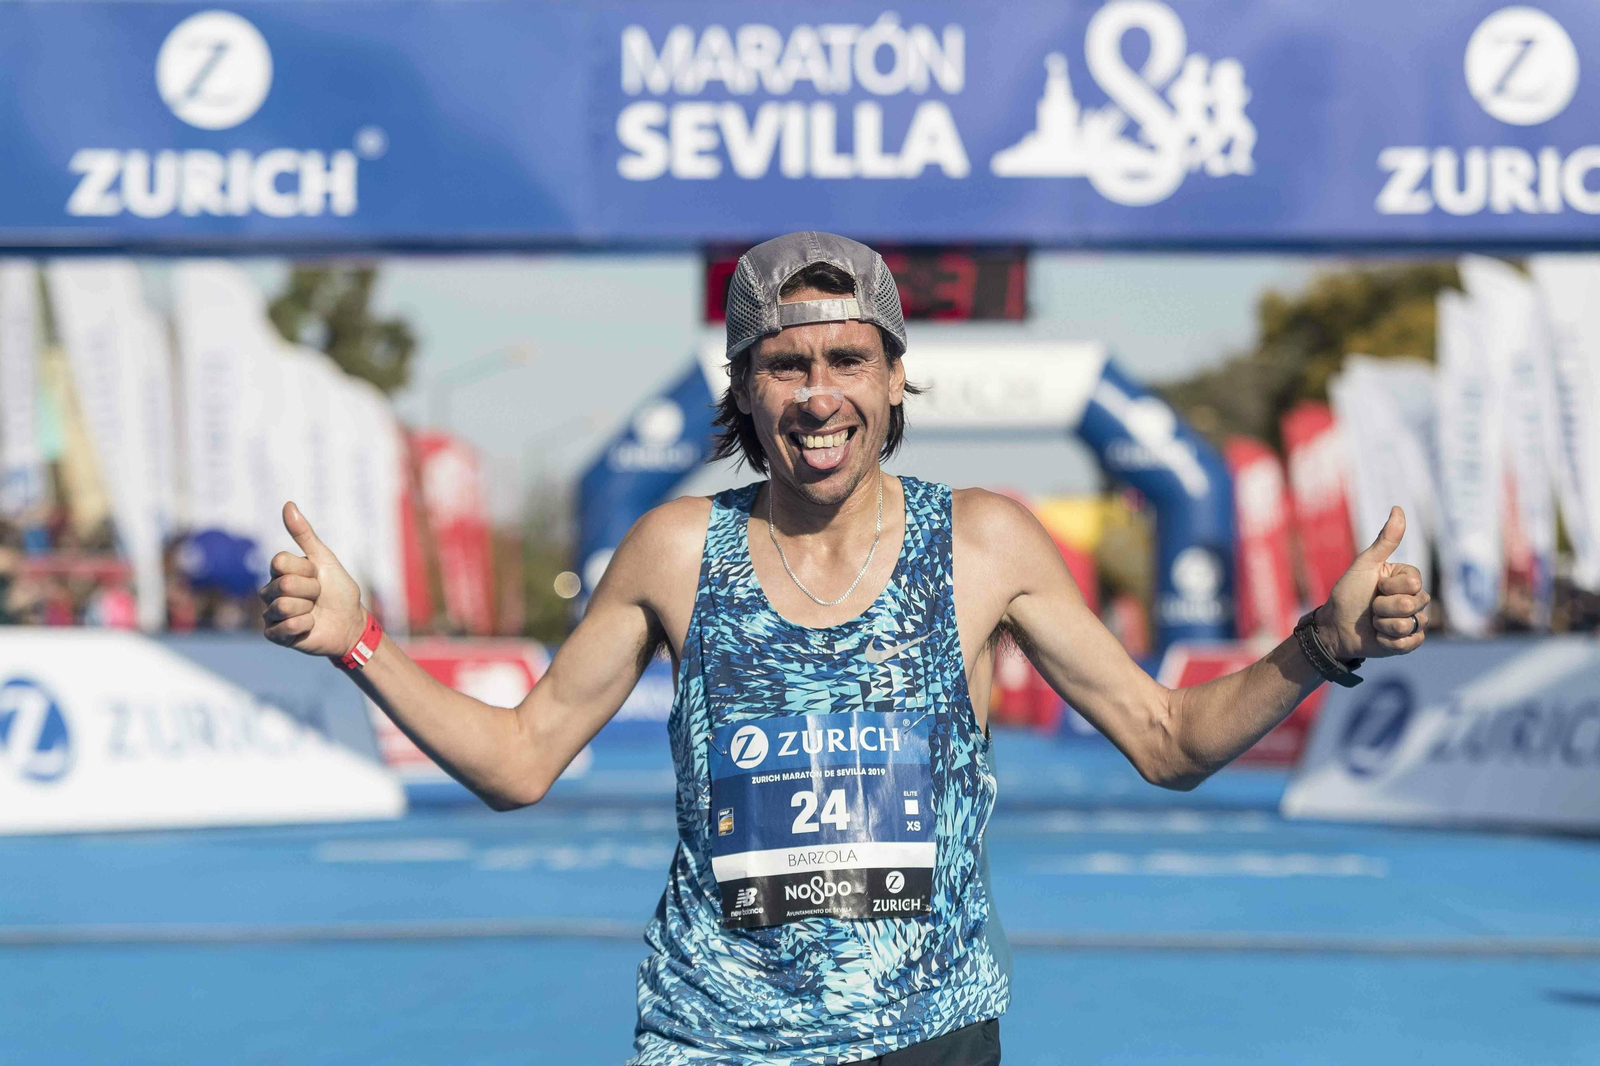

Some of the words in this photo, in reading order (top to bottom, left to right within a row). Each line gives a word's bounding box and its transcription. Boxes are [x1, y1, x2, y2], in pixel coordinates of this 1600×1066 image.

[620, 11, 966, 95] MARATÓN
[615, 100, 971, 181] SEVILLA
[66, 148, 359, 218] ZURICH
[1374, 145, 1600, 216] ZURIC
[777, 726, 900, 757] ZURICH
[751, 774, 780, 784] ZURICH
[825, 769, 835, 777] DE
[836, 768, 866, 777] SEVILLA
[868, 767, 886, 776] 2019
[790, 788, 851, 834] 24
[906, 821, 921, 831] XS
[788, 849, 858, 867] BARZOLA
[872, 898, 921, 912] ZURICH
